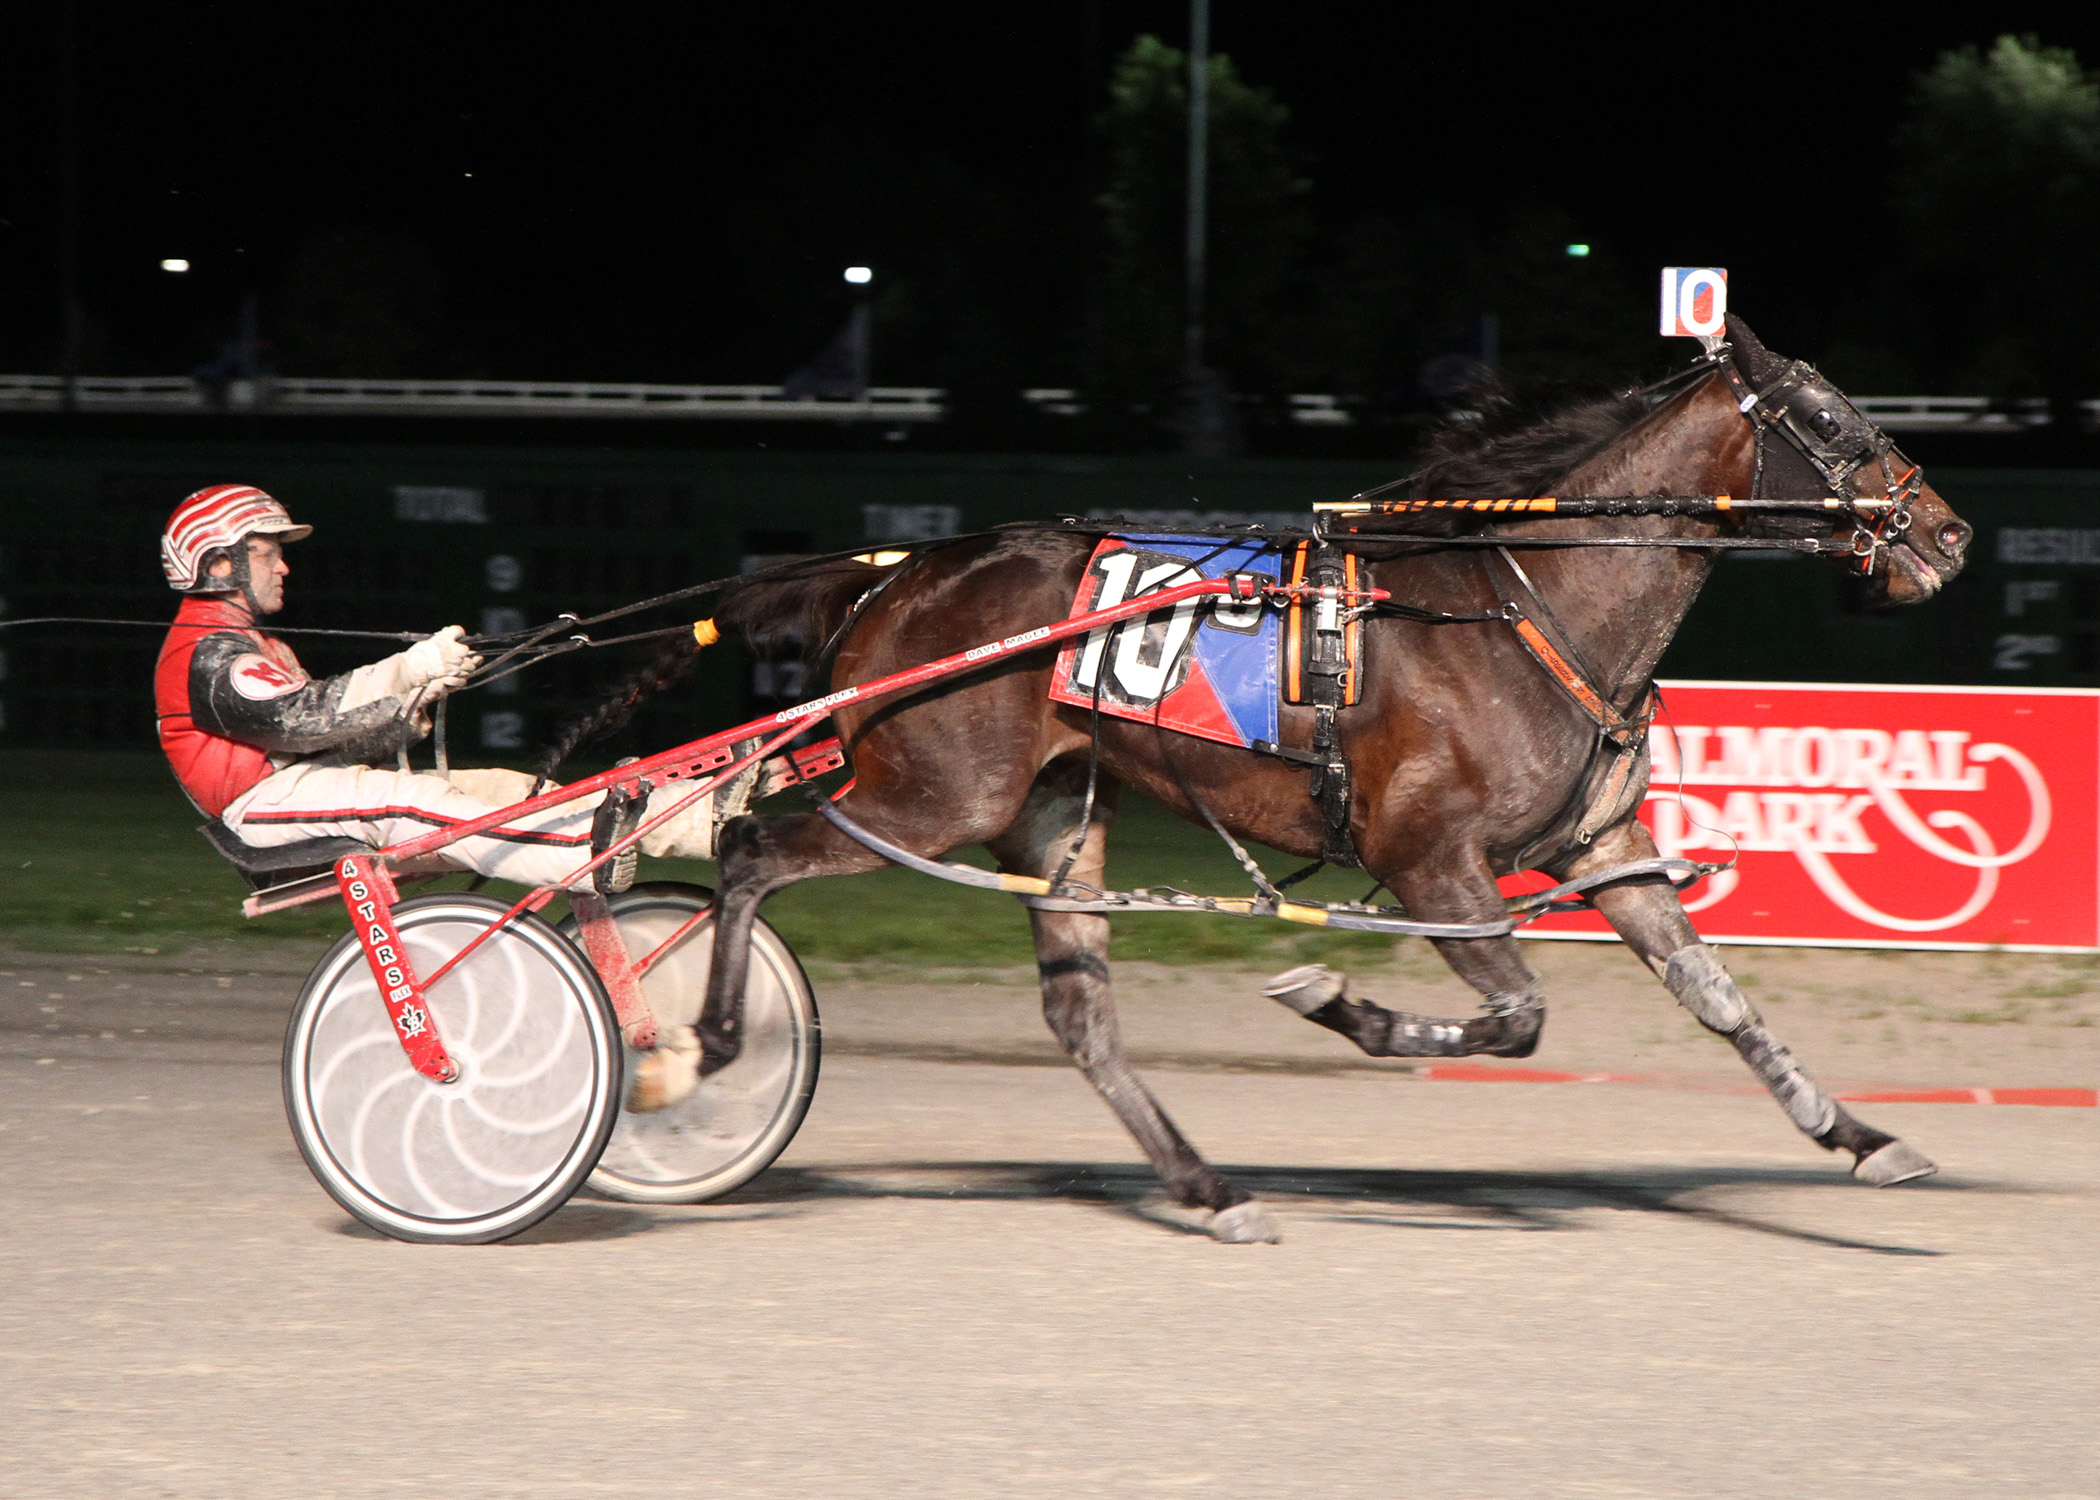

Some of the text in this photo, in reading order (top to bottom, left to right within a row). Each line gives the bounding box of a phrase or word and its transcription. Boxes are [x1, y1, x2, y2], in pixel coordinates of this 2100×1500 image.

[1661, 268, 1727, 336] 10
[967, 627, 1050, 660] DAVE MAGEE
[1077, 552, 1203, 700] 10
[777, 711, 786, 722] 4
[786, 698, 825, 719] STARS
[1648, 725, 1986, 791] ALMORAL
[1645, 790, 1877, 854] PARK
[342, 860, 403, 985] 4 STARS
[390, 987, 411, 1001] FLEX
